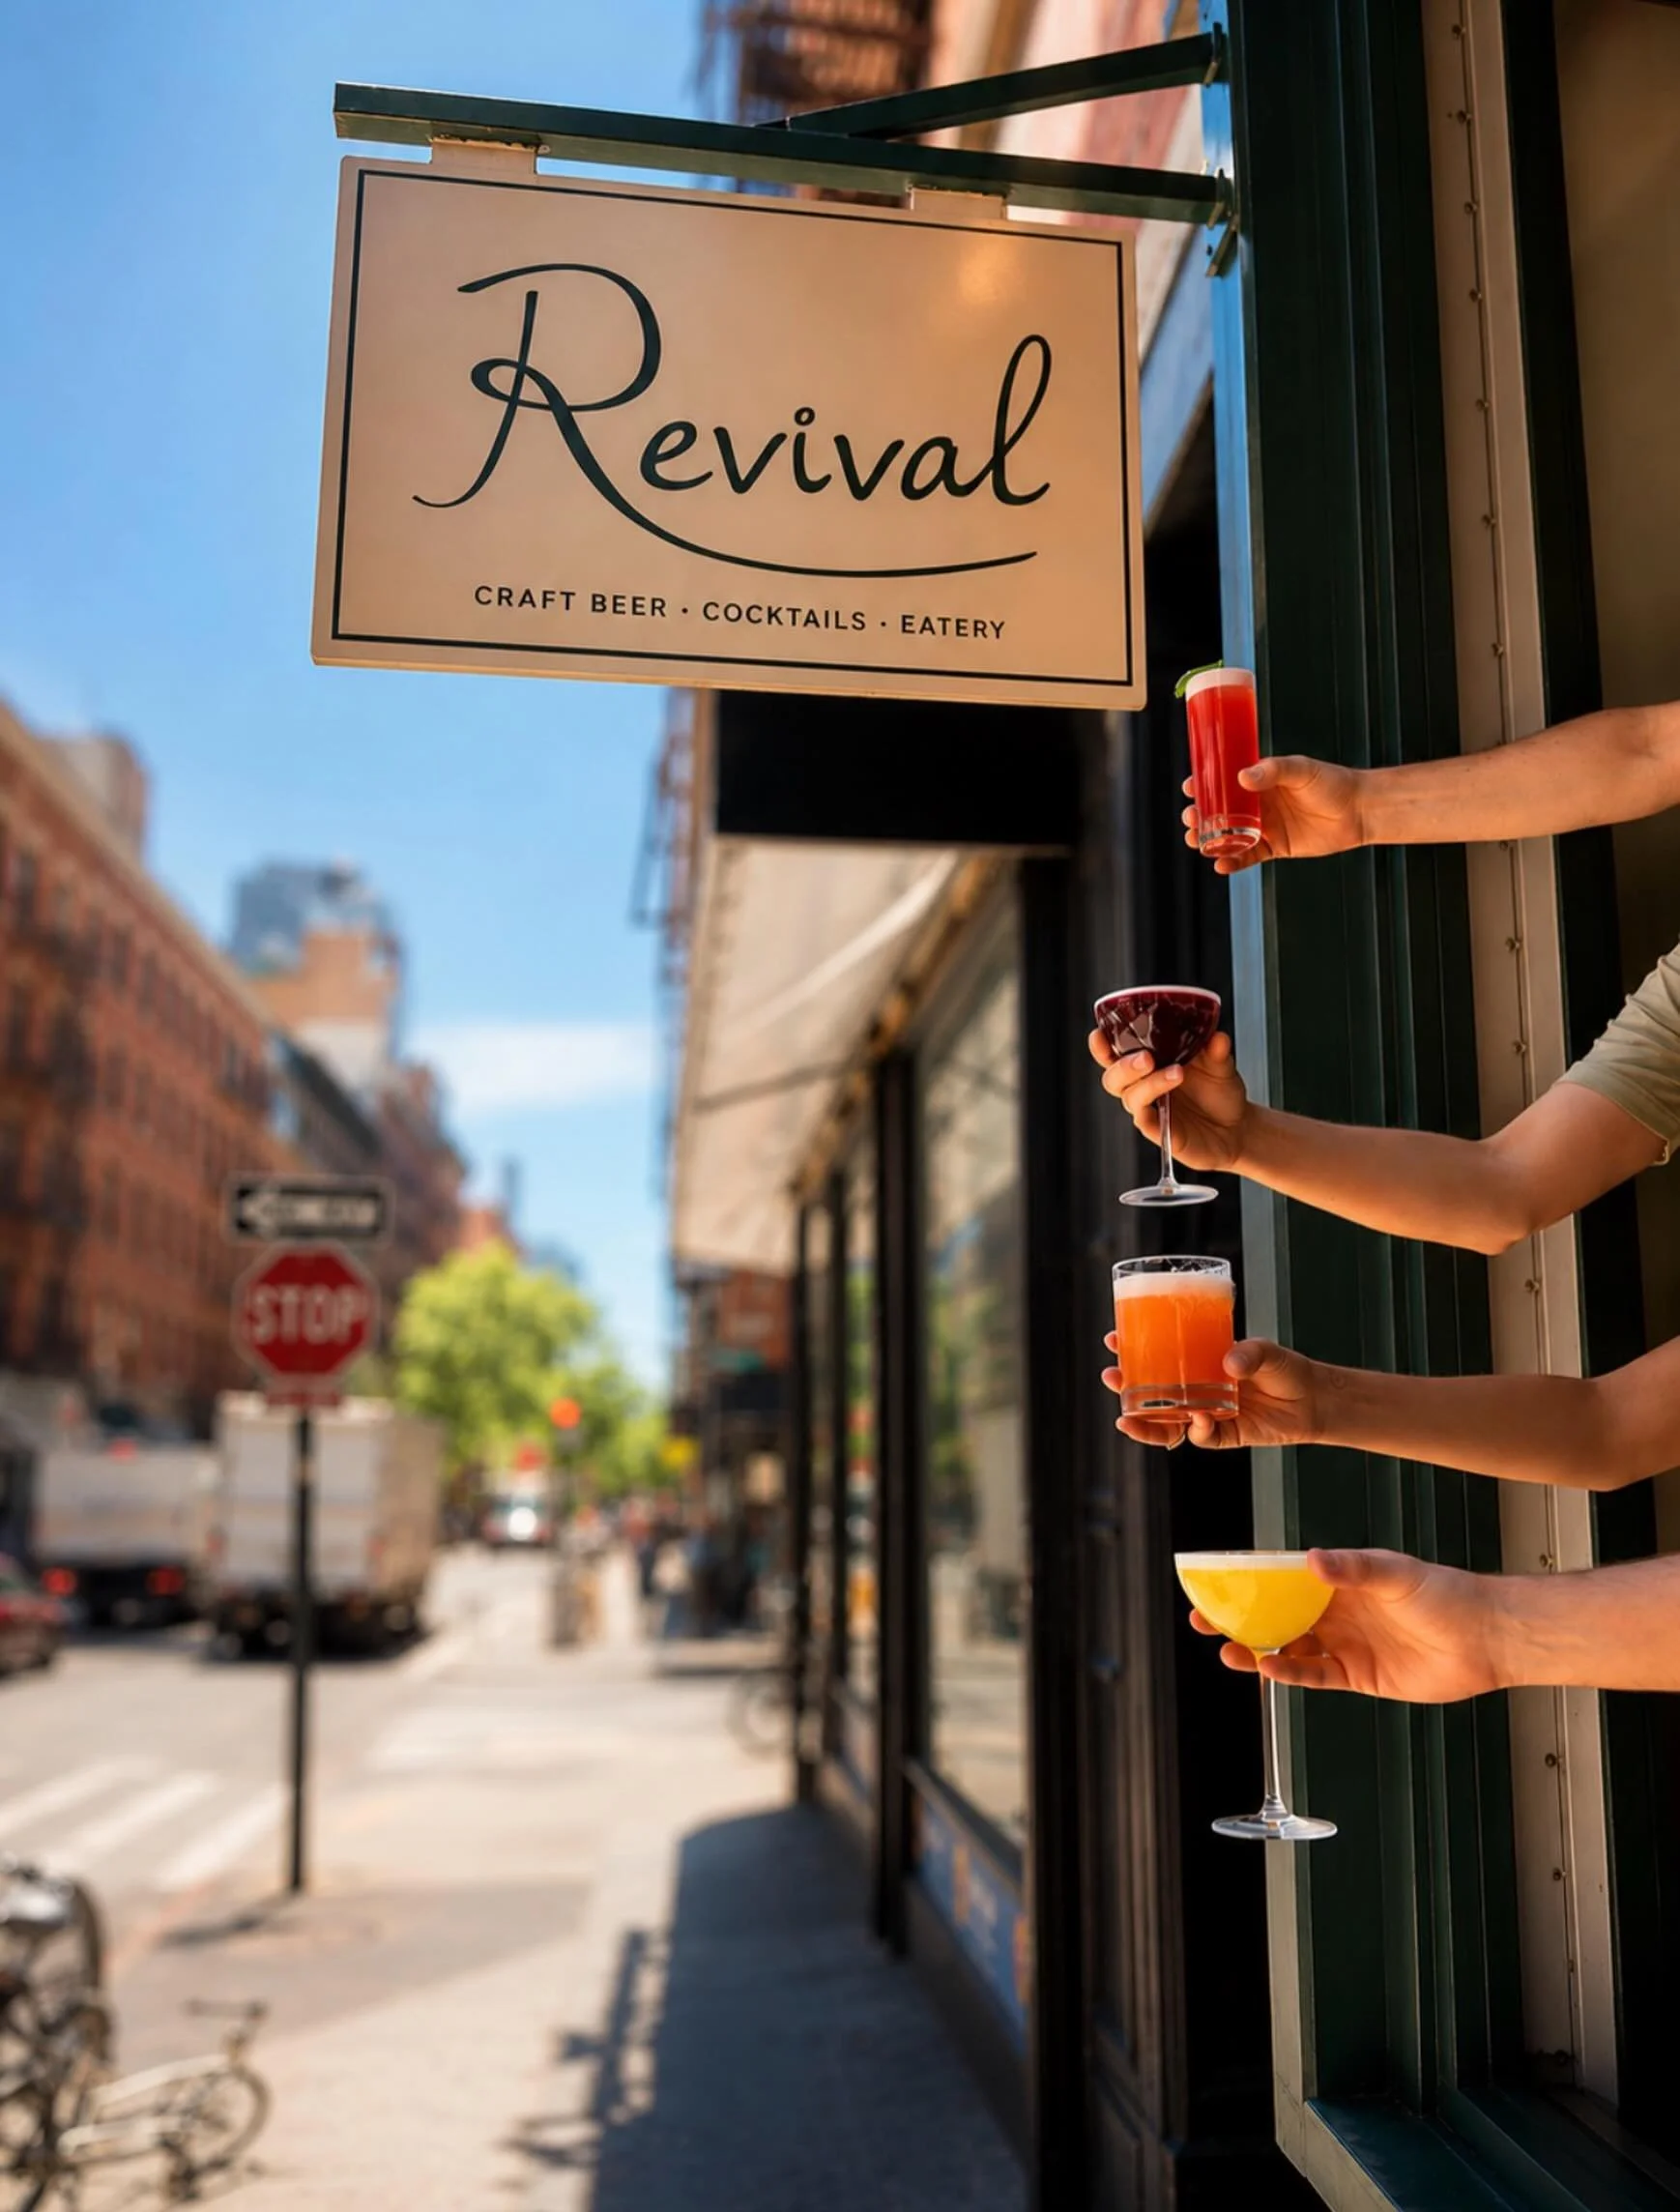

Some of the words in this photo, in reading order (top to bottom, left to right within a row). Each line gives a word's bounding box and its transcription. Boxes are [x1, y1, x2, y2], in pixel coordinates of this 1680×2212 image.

[412, 263, 1053, 579] Revival
[474, 585, 576, 611] CRAFT
[591, 593, 667, 618] BEER
[702, 601, 866, 631] COCKTAILS
[901, 614, 1005, 640] EATERY
[251, 1286, 367, 1345] STOP
